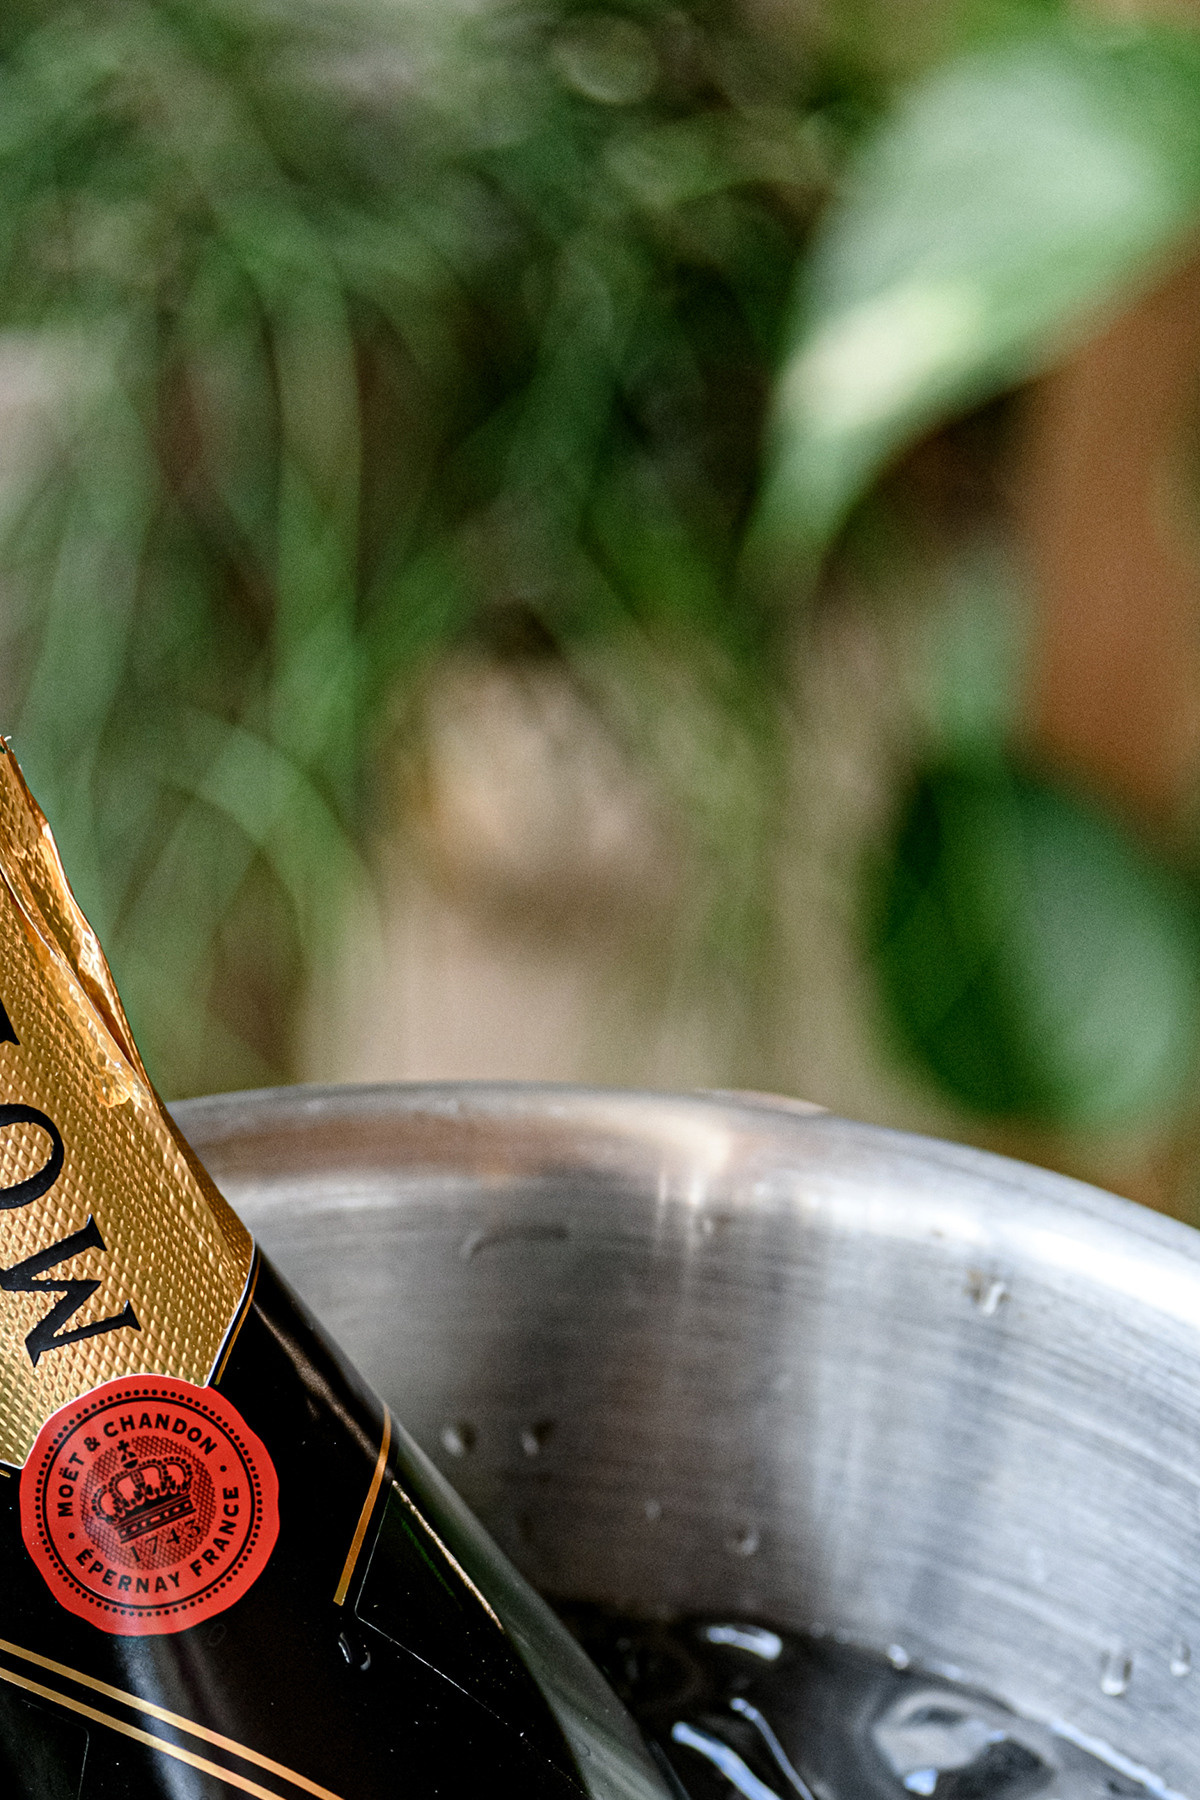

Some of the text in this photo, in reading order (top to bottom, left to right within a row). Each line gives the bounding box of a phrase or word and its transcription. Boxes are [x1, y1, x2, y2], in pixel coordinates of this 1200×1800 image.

[57, 1411, 218, 1518] MOËT & CHANDON
[75, 1485, 240, 1593] ÉPERNAY FRANCE
[130, 1518, 202, 1563] 1743
